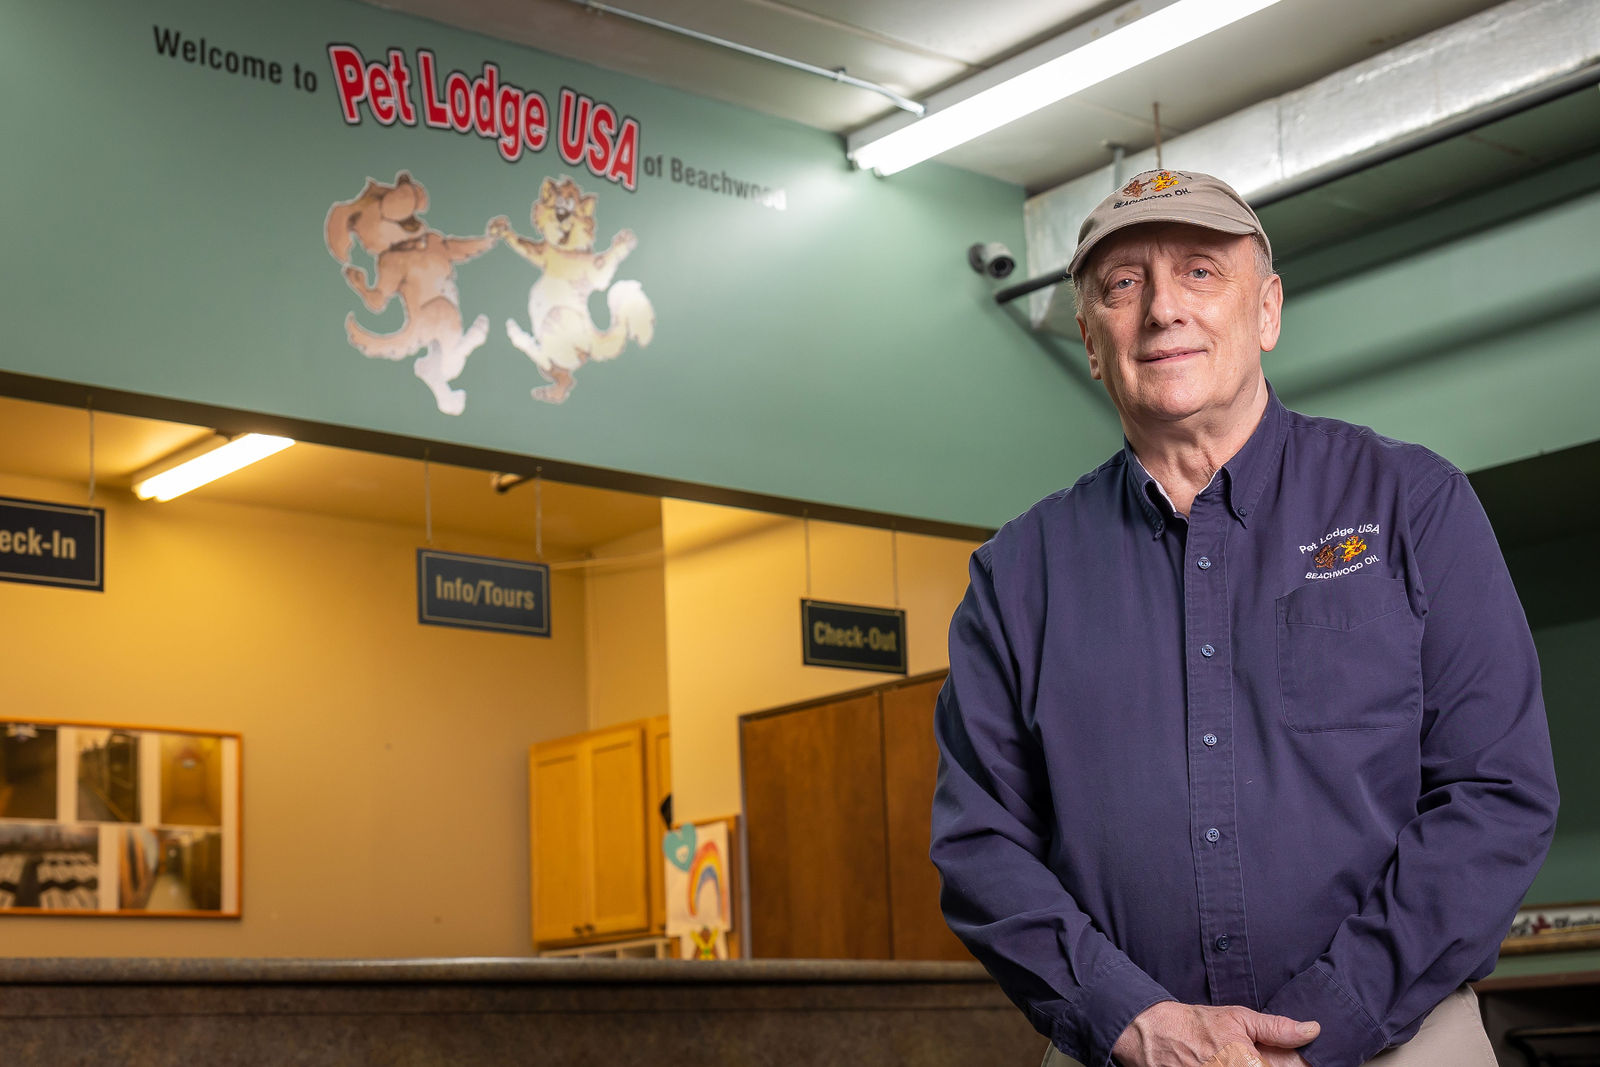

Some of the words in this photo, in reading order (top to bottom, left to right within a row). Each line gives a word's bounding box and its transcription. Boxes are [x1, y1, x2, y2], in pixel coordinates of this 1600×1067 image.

[153, 25, 282, 84] Welcome
[294, 63, 318, 93] to
[328, 43, 418, 126] Pet
[417, 48, 550, 162] Lodge
[557, 87, 641, 192] USA
[643, 155, 663, 177] of
[1299, 542, 1319, 554] Pet
[1320, 527, 1354, 545] Lodge
[1357, 523, 1380, 534] USA
[1305, 562, 1363, 579] BEACHWOOD
[435, 574, 535, 611] Info/Tours
[813, 620, 897, 652] Check-Out
